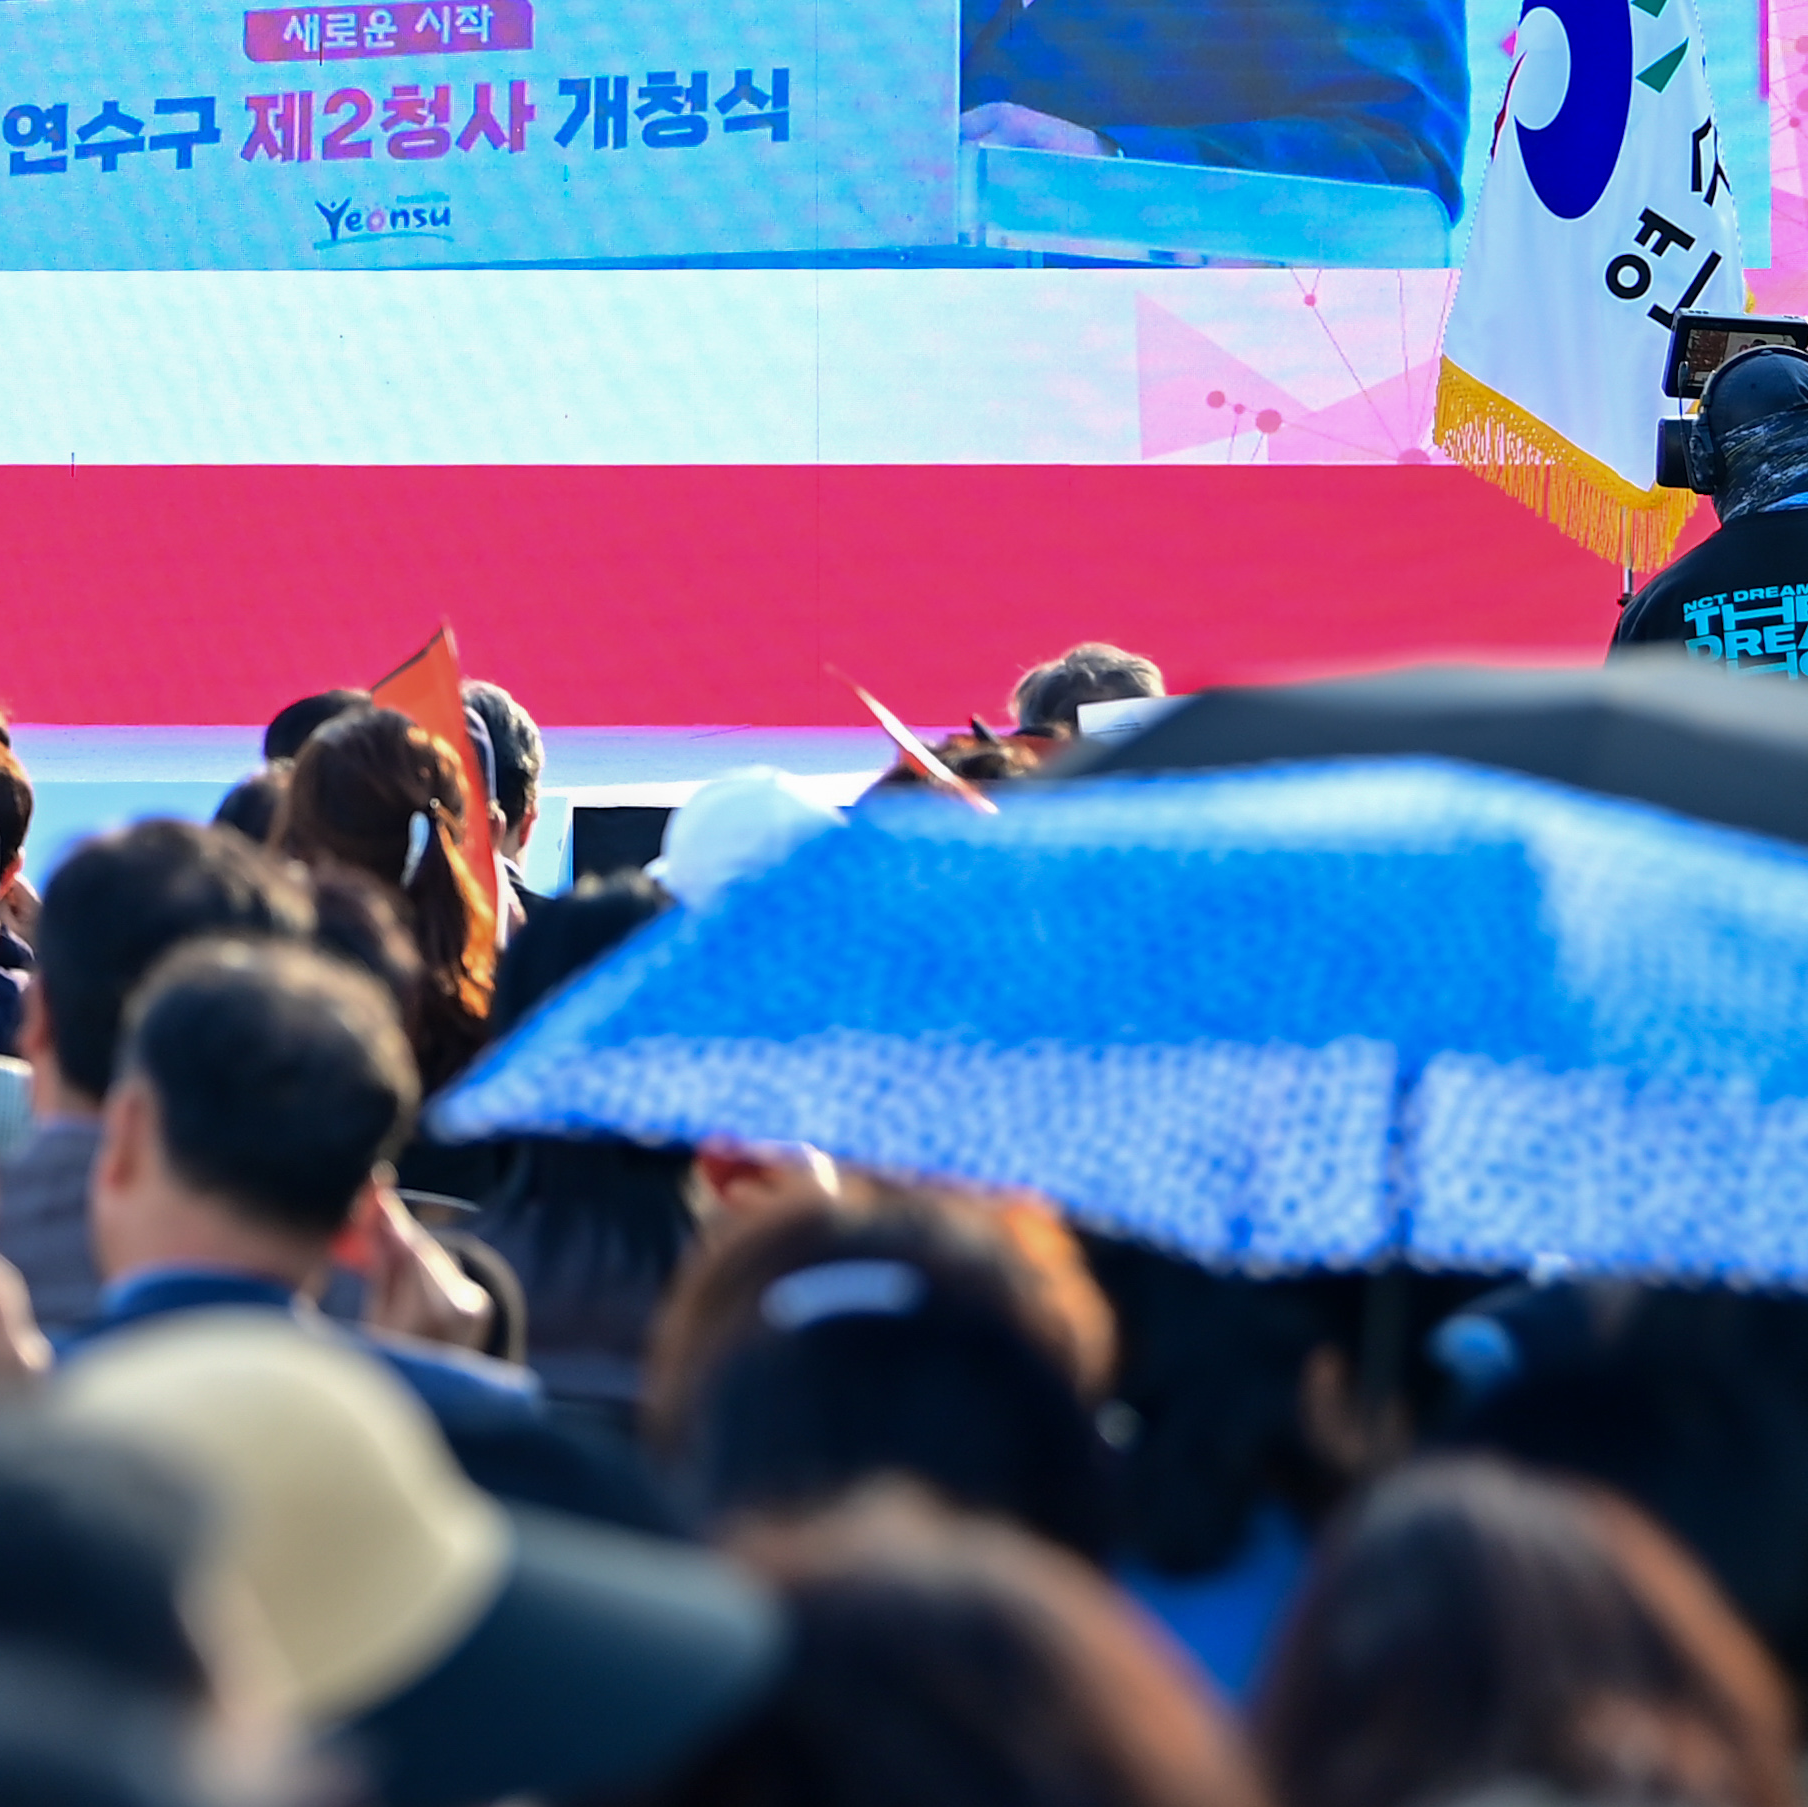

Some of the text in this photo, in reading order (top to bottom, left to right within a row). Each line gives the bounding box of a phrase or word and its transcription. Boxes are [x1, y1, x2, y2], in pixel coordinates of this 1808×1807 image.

[283, 3, 495, 52] 새로운 시작
[2, 67, 790, 176] 연수구 제2청사 개청식
[314, 196, 451, 242] Yeonsu
[1683, 593, 1727, 613] NCT
